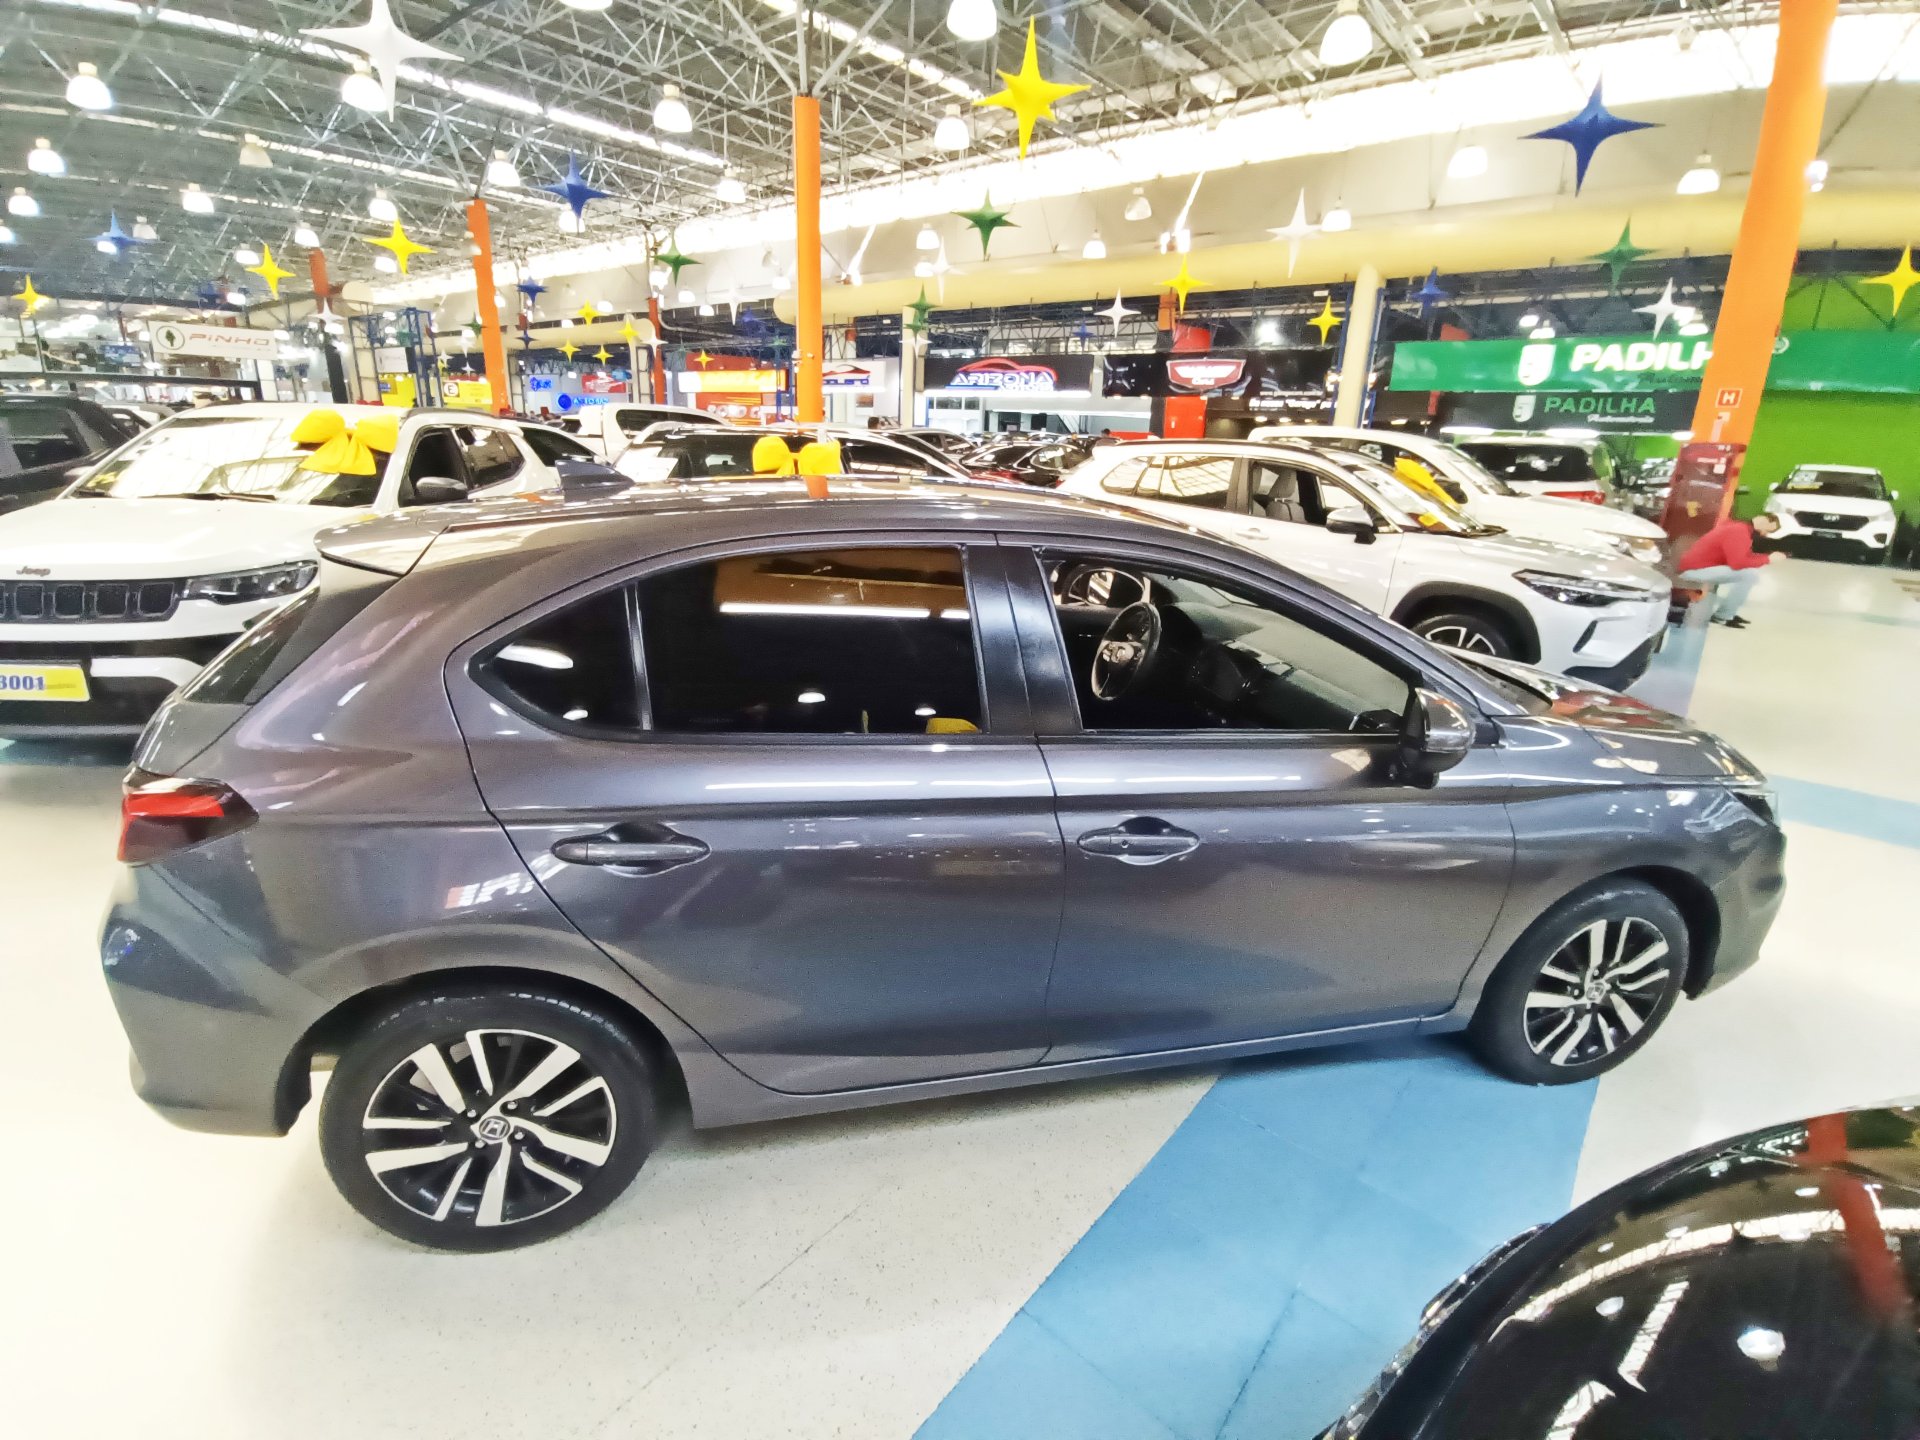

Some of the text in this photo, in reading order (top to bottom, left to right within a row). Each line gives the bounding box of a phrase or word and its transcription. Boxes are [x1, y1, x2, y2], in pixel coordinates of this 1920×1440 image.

[189, 333, 270, 346] PINHO
[1569, 341, 1714, 372] PADILH
[949, 371, 1055, 387] ARIZONA
[1544, 396, 1656, 414] PADILHA
